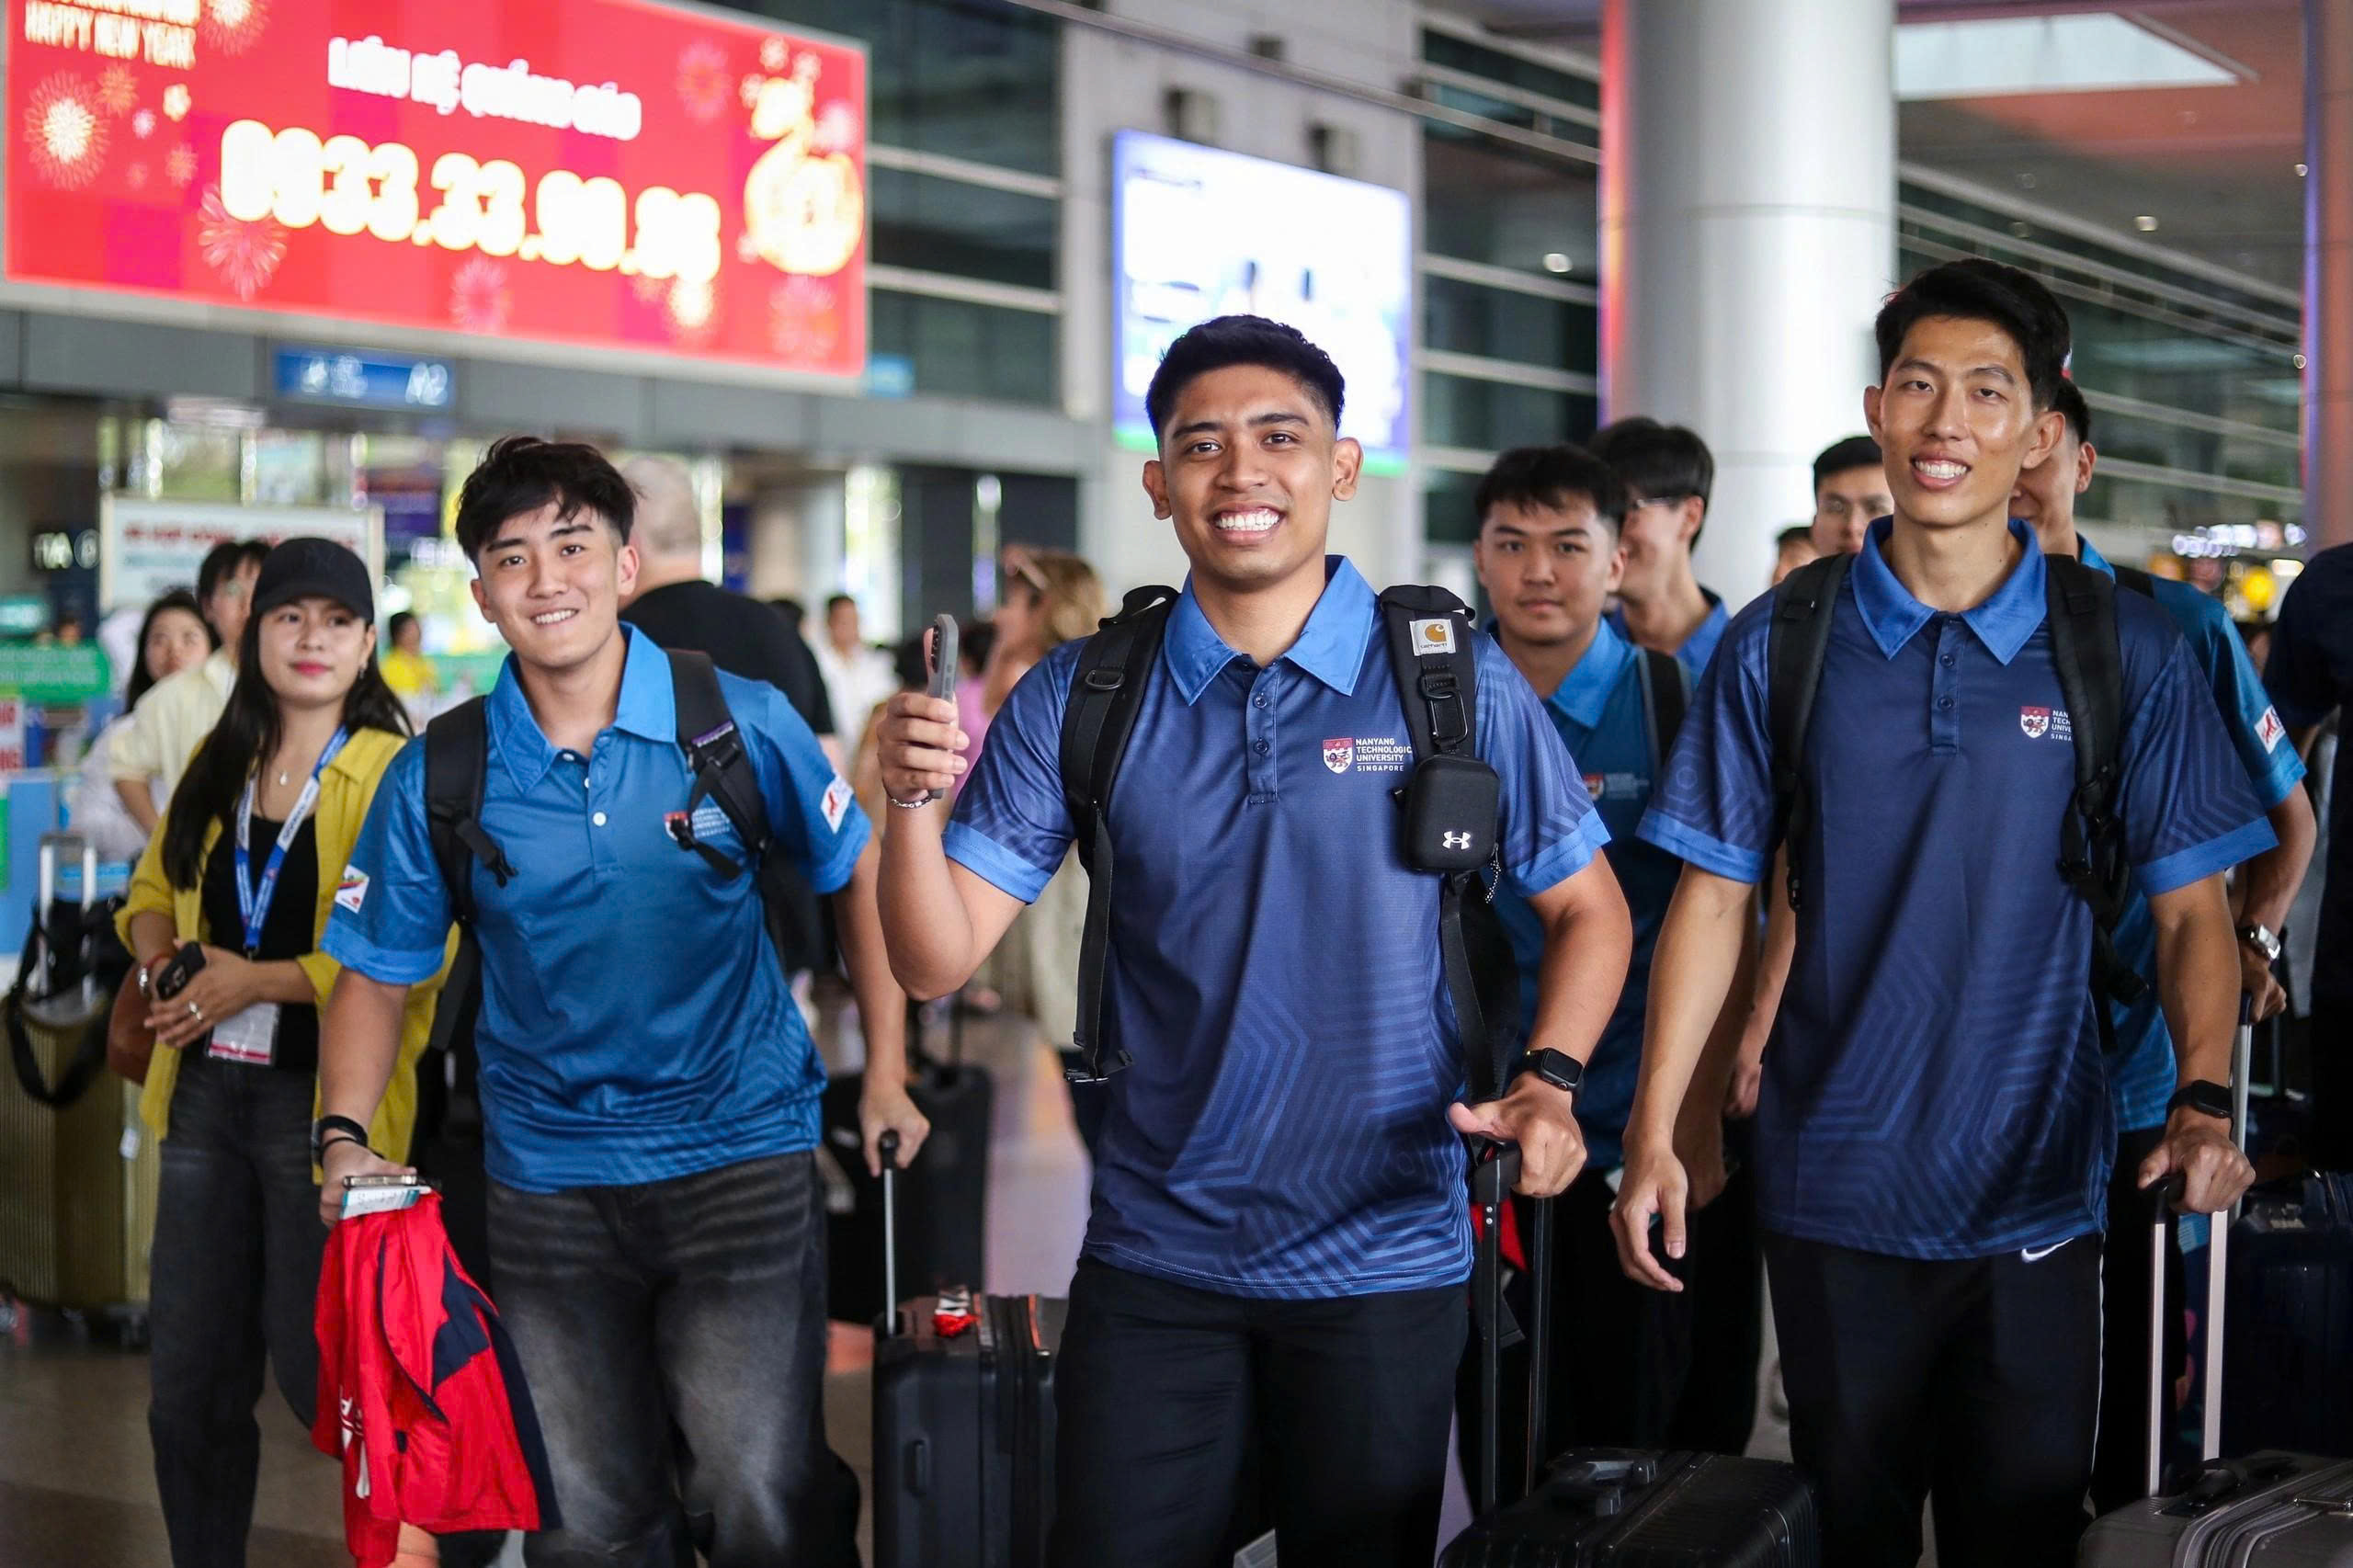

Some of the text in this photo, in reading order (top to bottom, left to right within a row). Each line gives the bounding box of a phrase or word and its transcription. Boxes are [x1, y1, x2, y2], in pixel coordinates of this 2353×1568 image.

[1355, 737, 1395, 746] NANYANG
[1356, 745, 1413, 754] TECHNOLOGIC
[1356, 754, 1404, 762] UNIVERSITY
